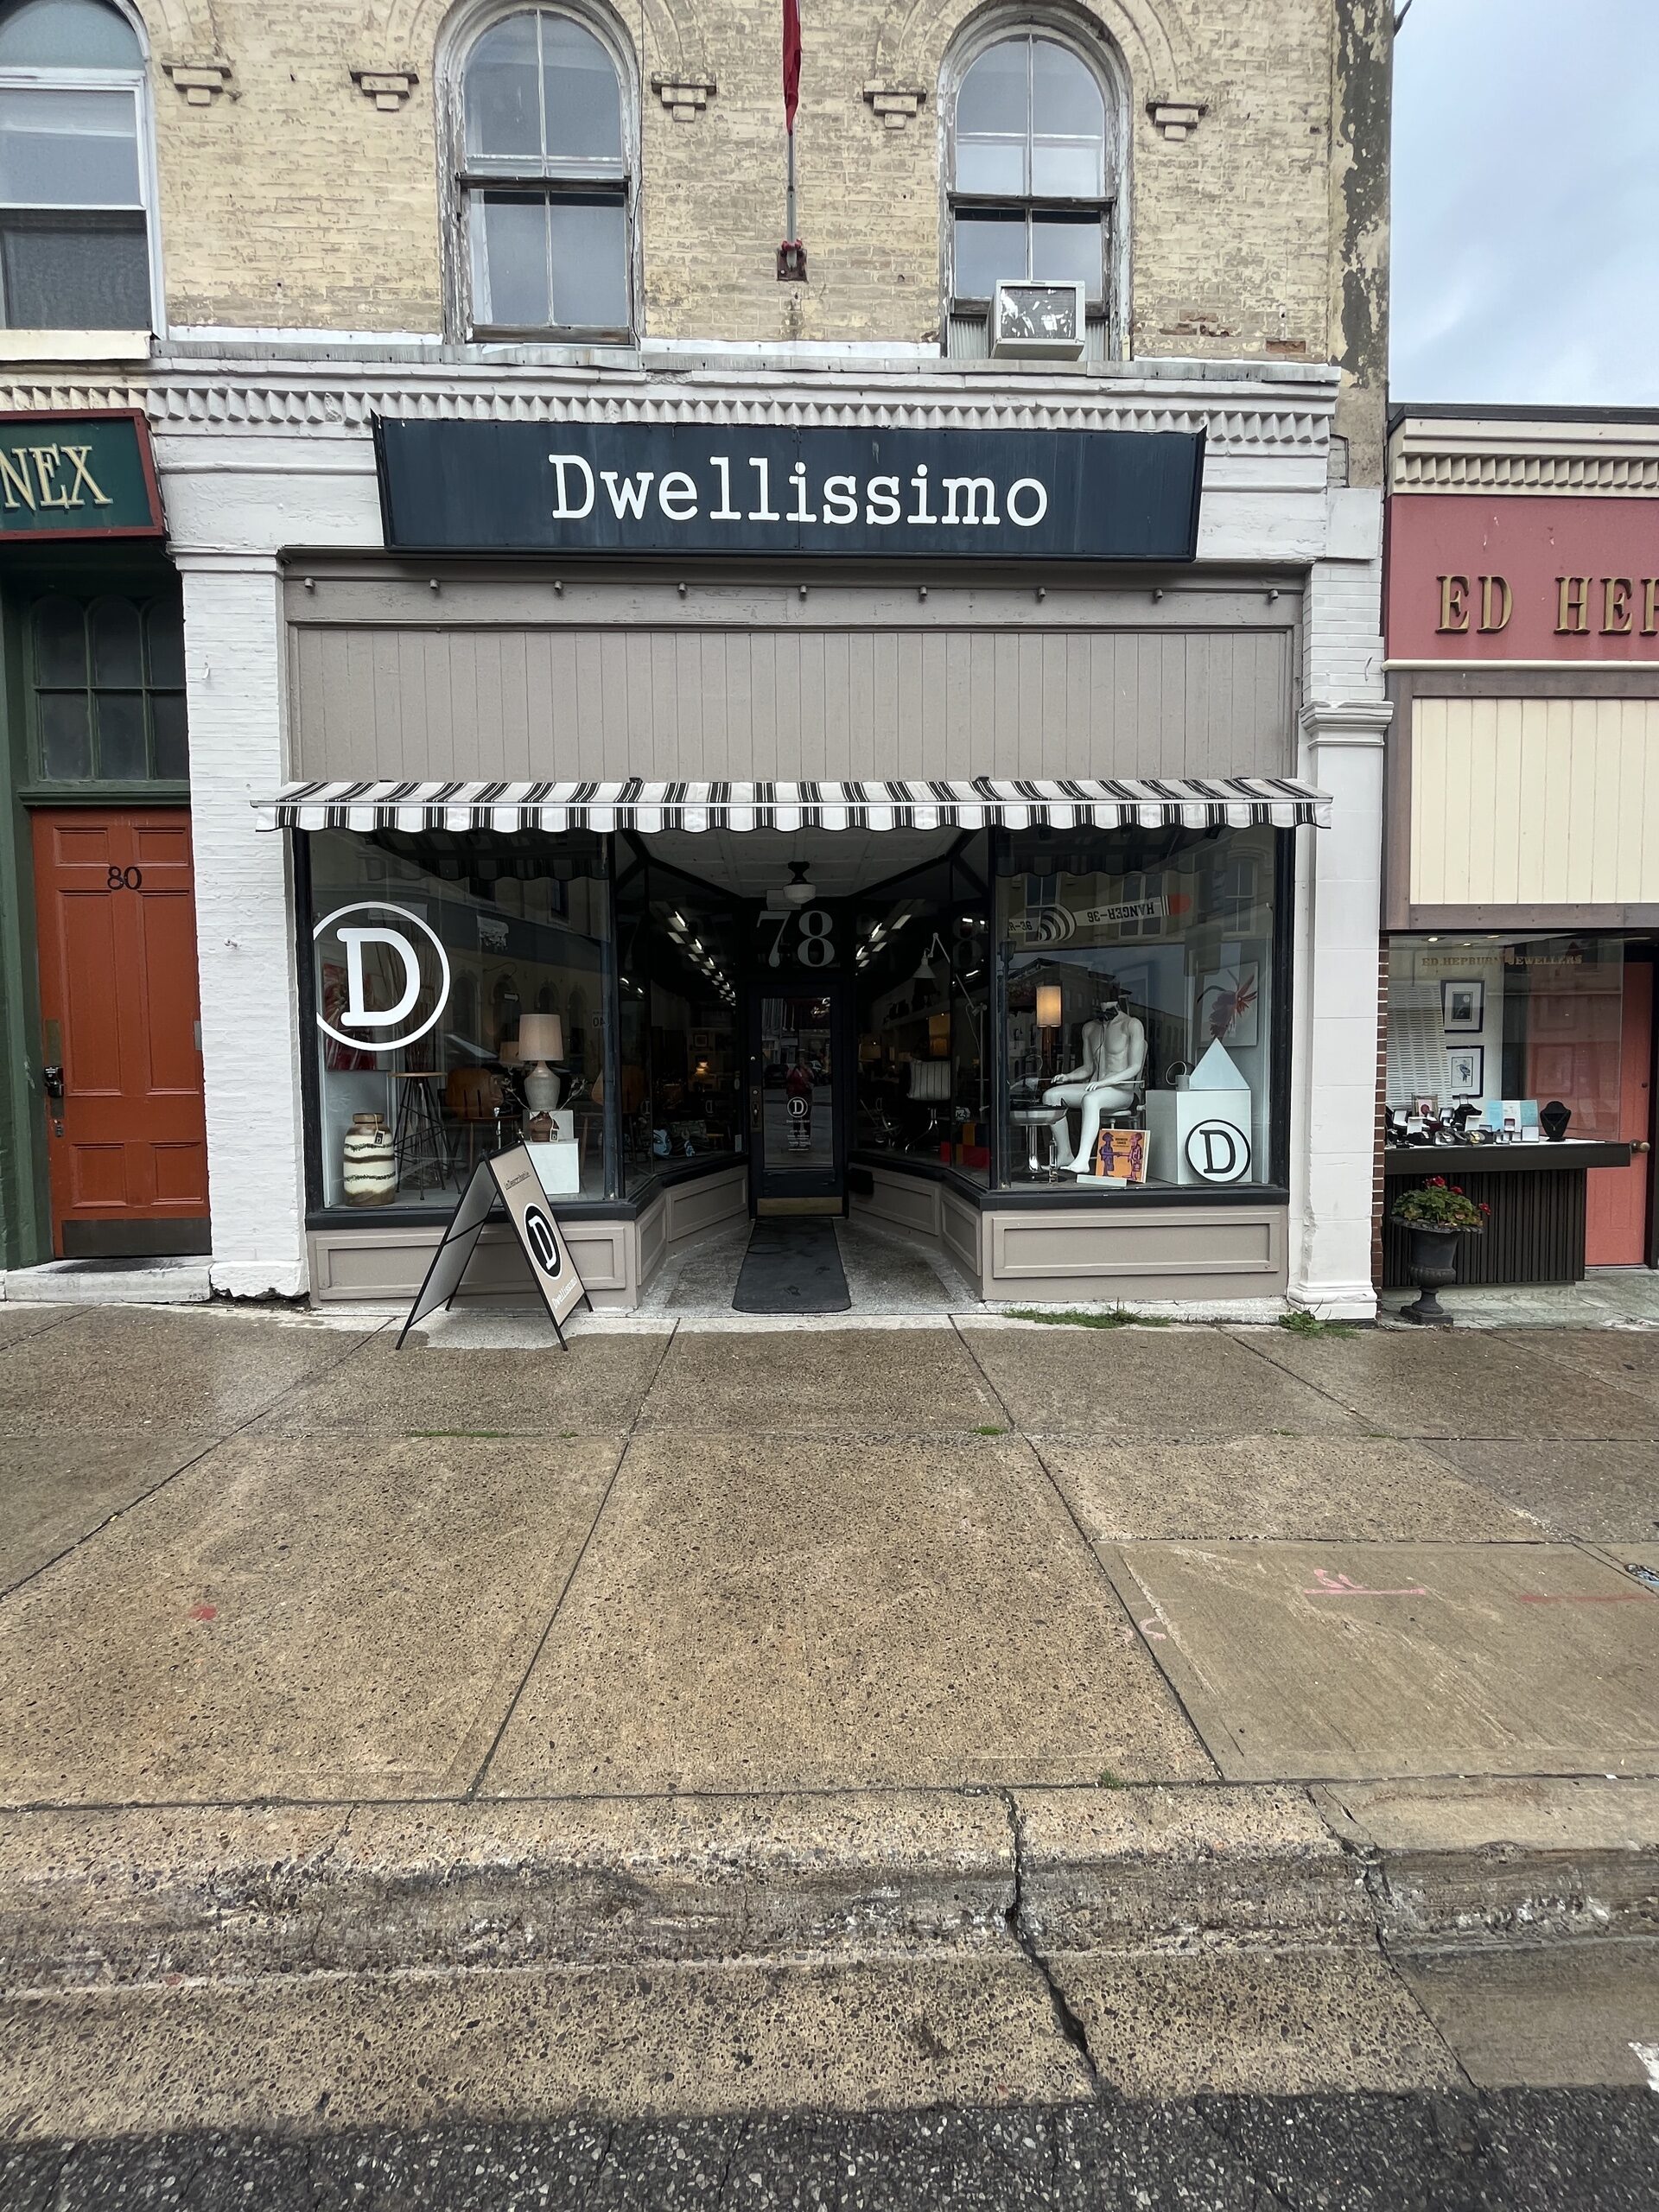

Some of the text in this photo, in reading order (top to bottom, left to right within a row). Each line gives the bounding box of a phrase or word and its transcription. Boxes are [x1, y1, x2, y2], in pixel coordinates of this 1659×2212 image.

[549, 454, 1047, 526] Dwellissimo
[1435, 575, 1513, 634] ED
[107, 866, 142, 890] 80
[756, 910, 836, 968] 78
[336, 928, 421, 1027] D
[1199, 1129, 1236, 1174] D
[528, 1215, 557, 1271] D
